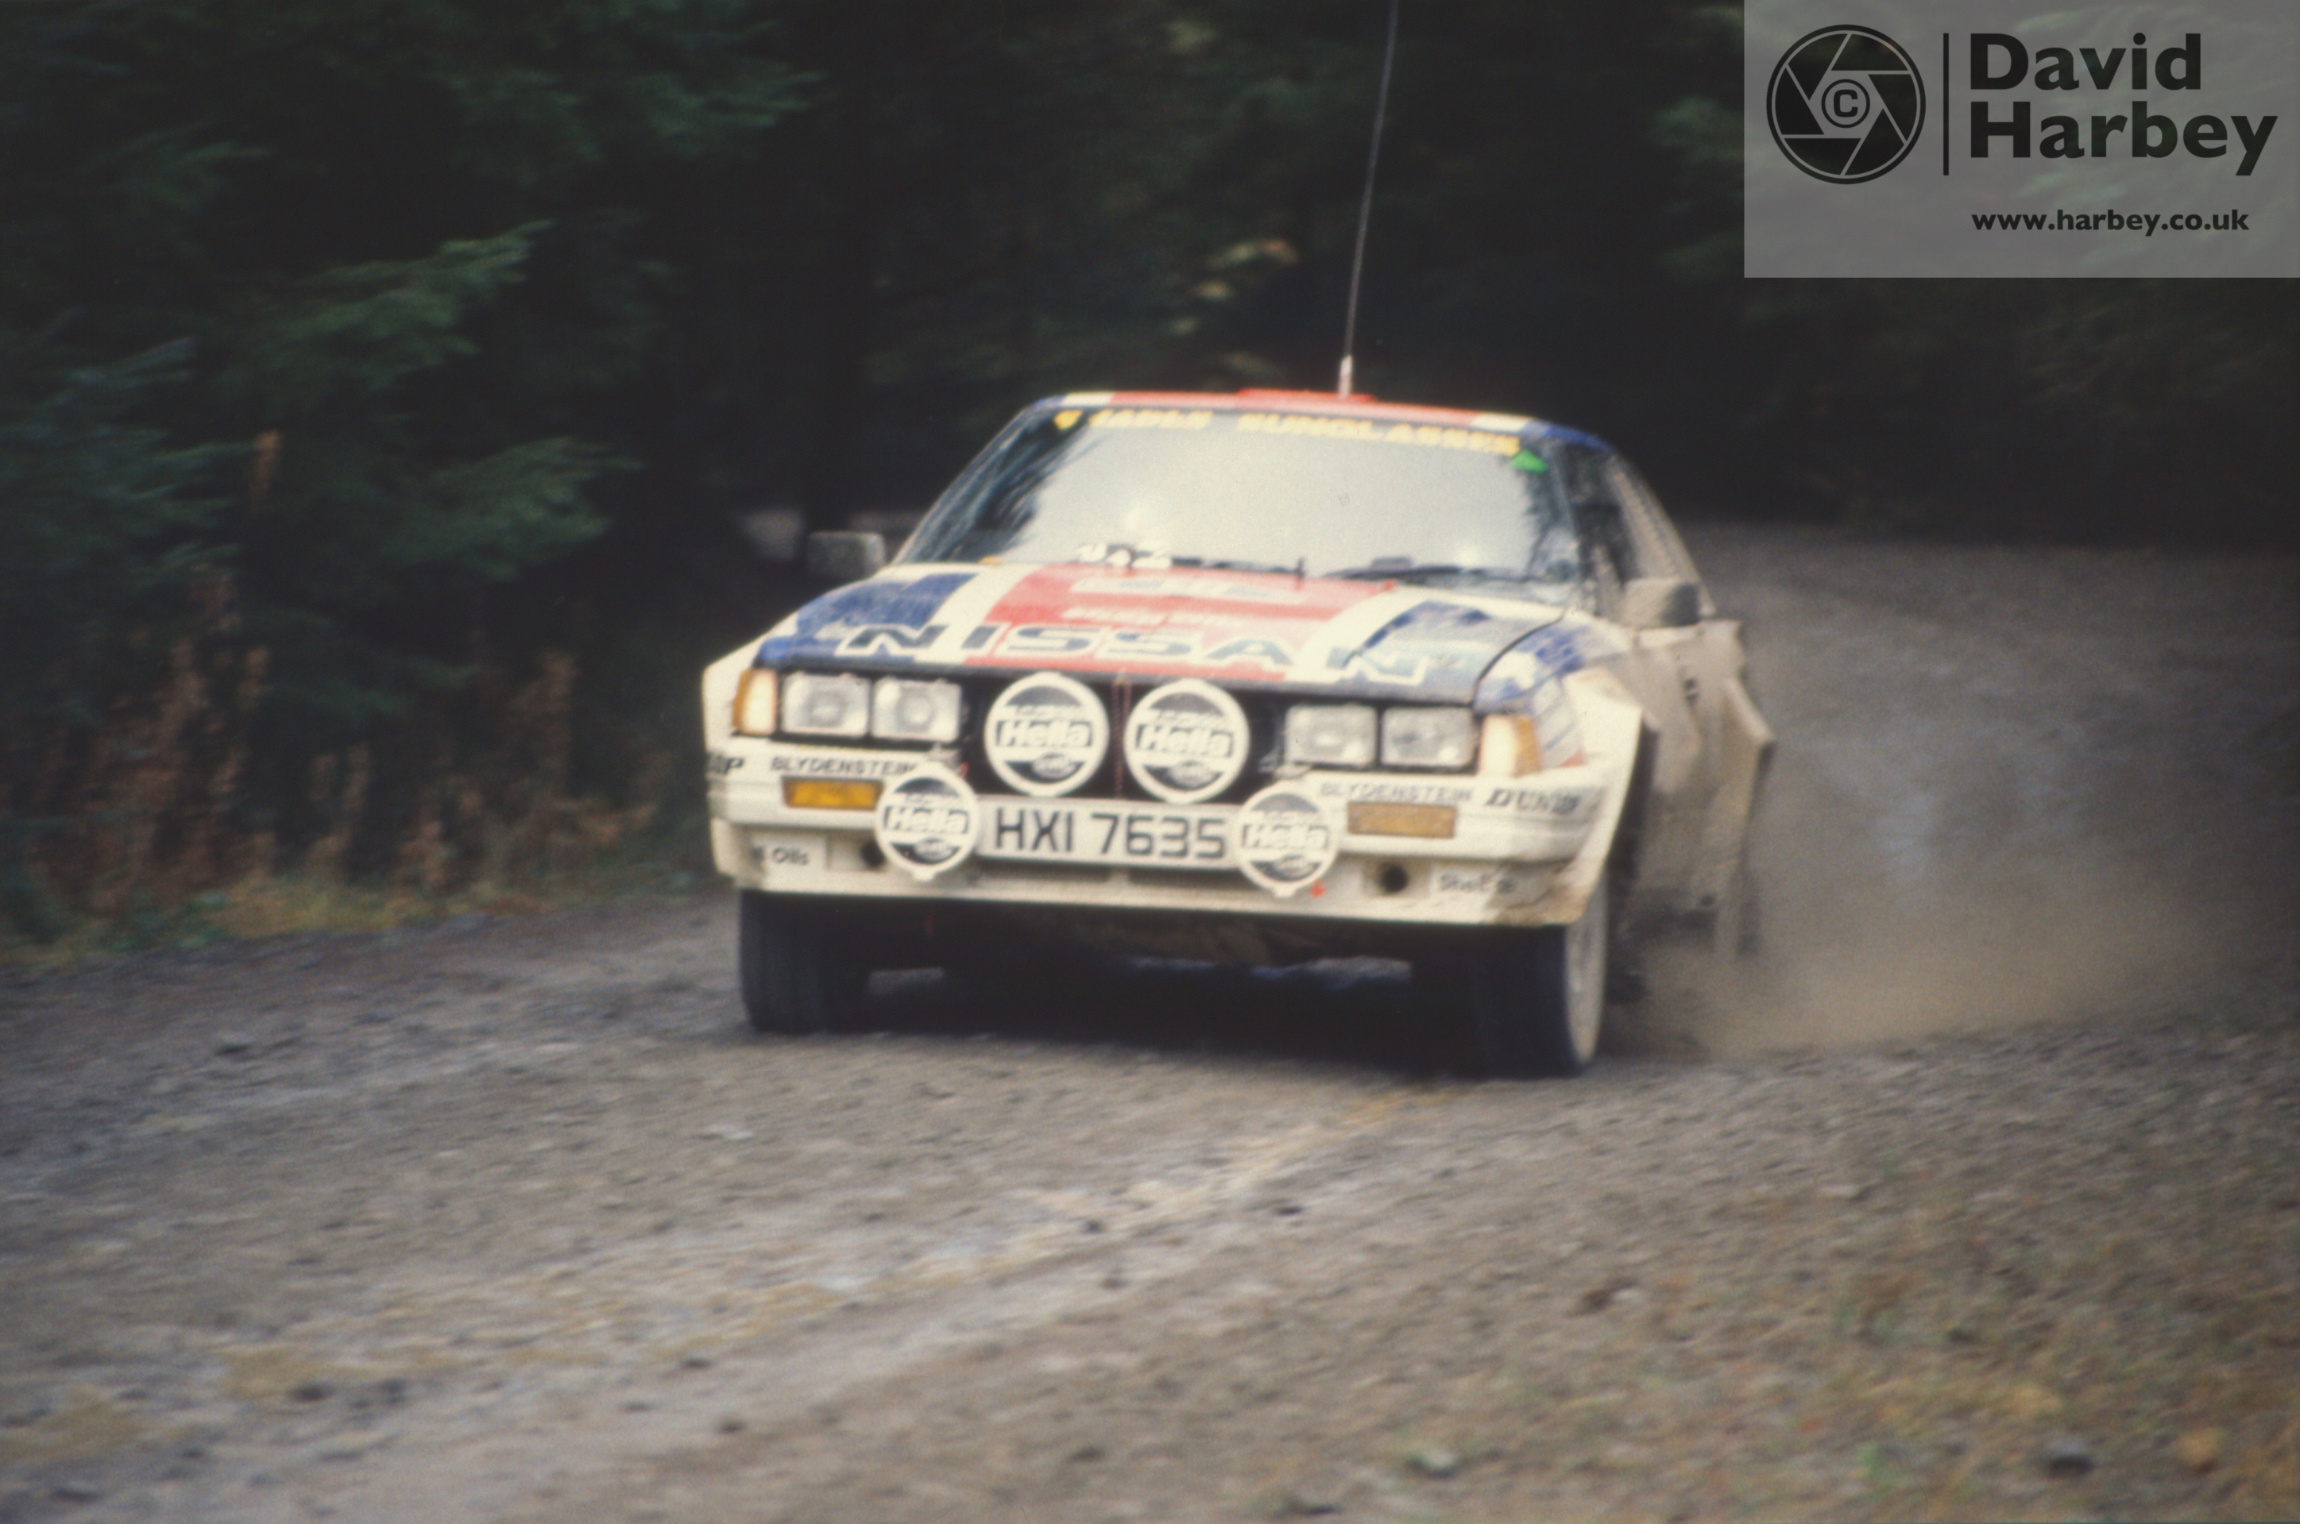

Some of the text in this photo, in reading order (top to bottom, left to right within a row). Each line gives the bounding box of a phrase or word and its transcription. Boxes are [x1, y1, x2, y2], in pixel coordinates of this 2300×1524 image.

[838, 621, 1430, 686] NISSAN
[999, 719, 1091, 748] Hella
[1139, 724, 1235, 757] Hella
[995, 810, 1074, 854] HXI
[1092, 813, 1227, 858] 7635
